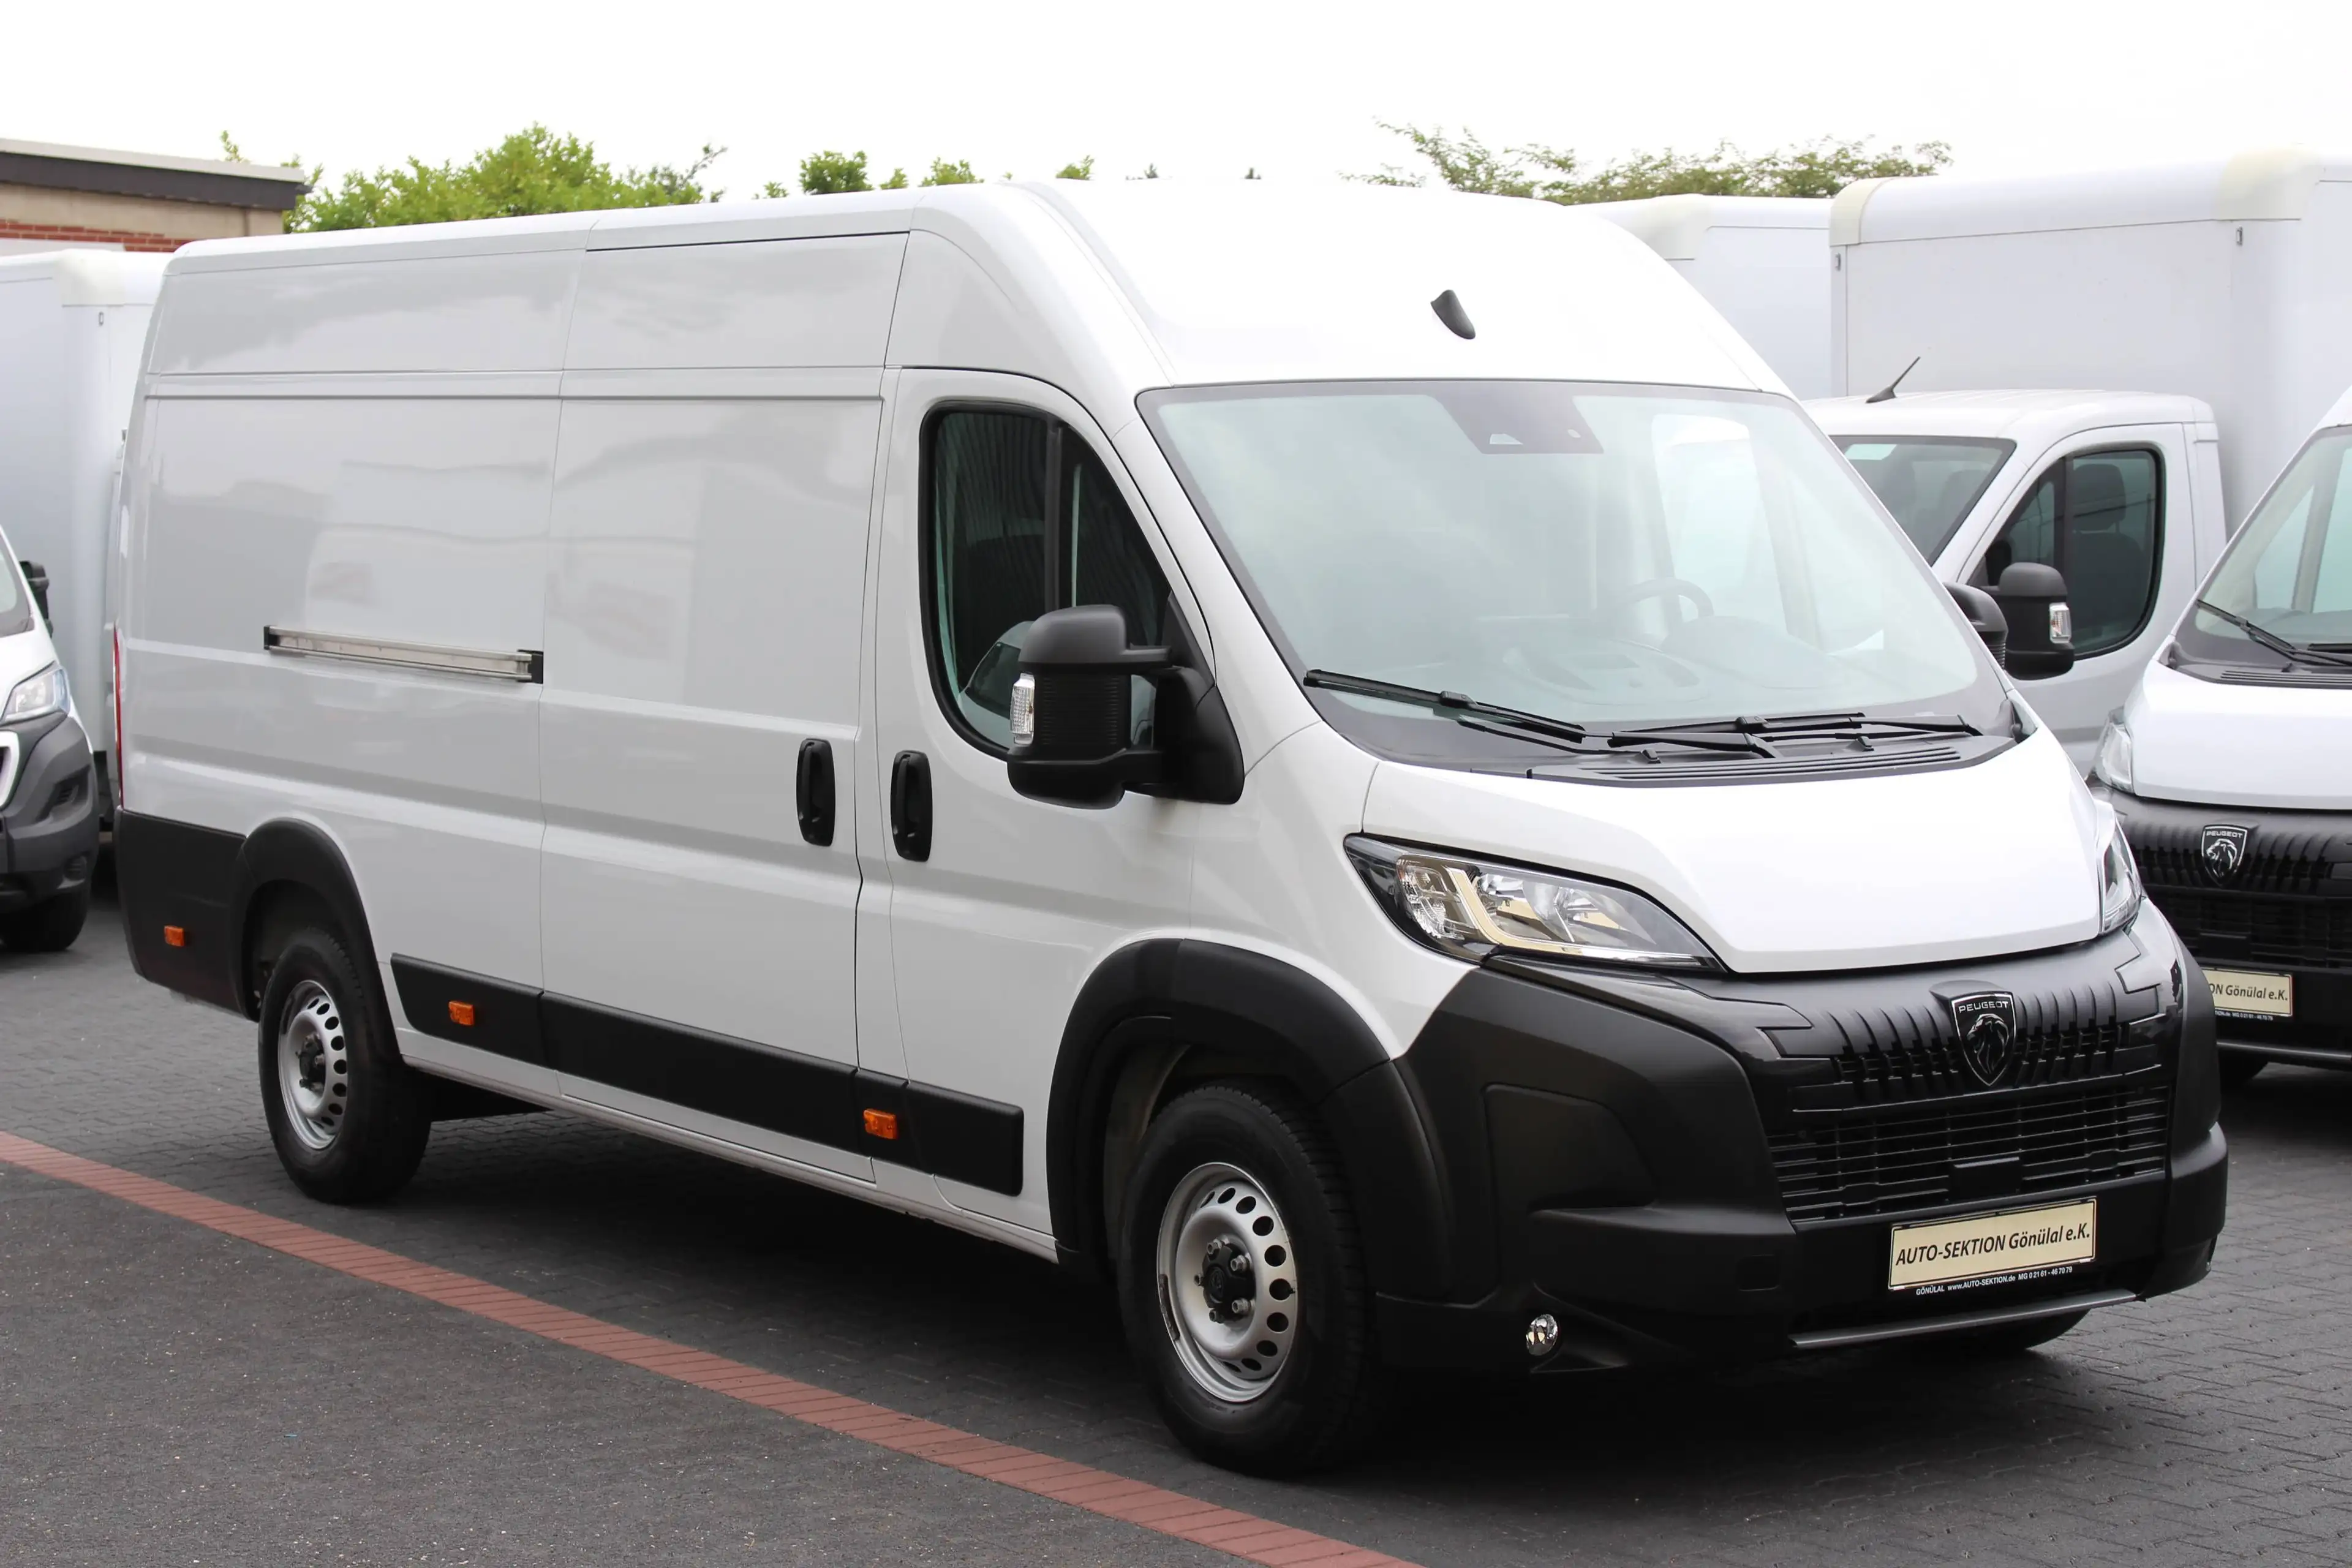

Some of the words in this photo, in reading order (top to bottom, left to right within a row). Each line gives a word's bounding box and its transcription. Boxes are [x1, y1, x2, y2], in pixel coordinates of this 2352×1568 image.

[2209, 983, 2223, 995] ON
[2226, 985, 2267, 999] Gönülal
[2268, 989, 2288, 1001] e.K.
[1958, 1001, 2009, 1013] PEUGEOT
[1896, 1235, 2006, 1266] AUTO-SEKTION
[2009, 1226, 2064, 1248] Gönülal
[2066, 1223, 2090, 1241] e.K.
[1916, 1285, 1945, 1295] GÖNÜLAL
[1947, 1275, 2016, 1291] www.AUTO-SEKTION.de
